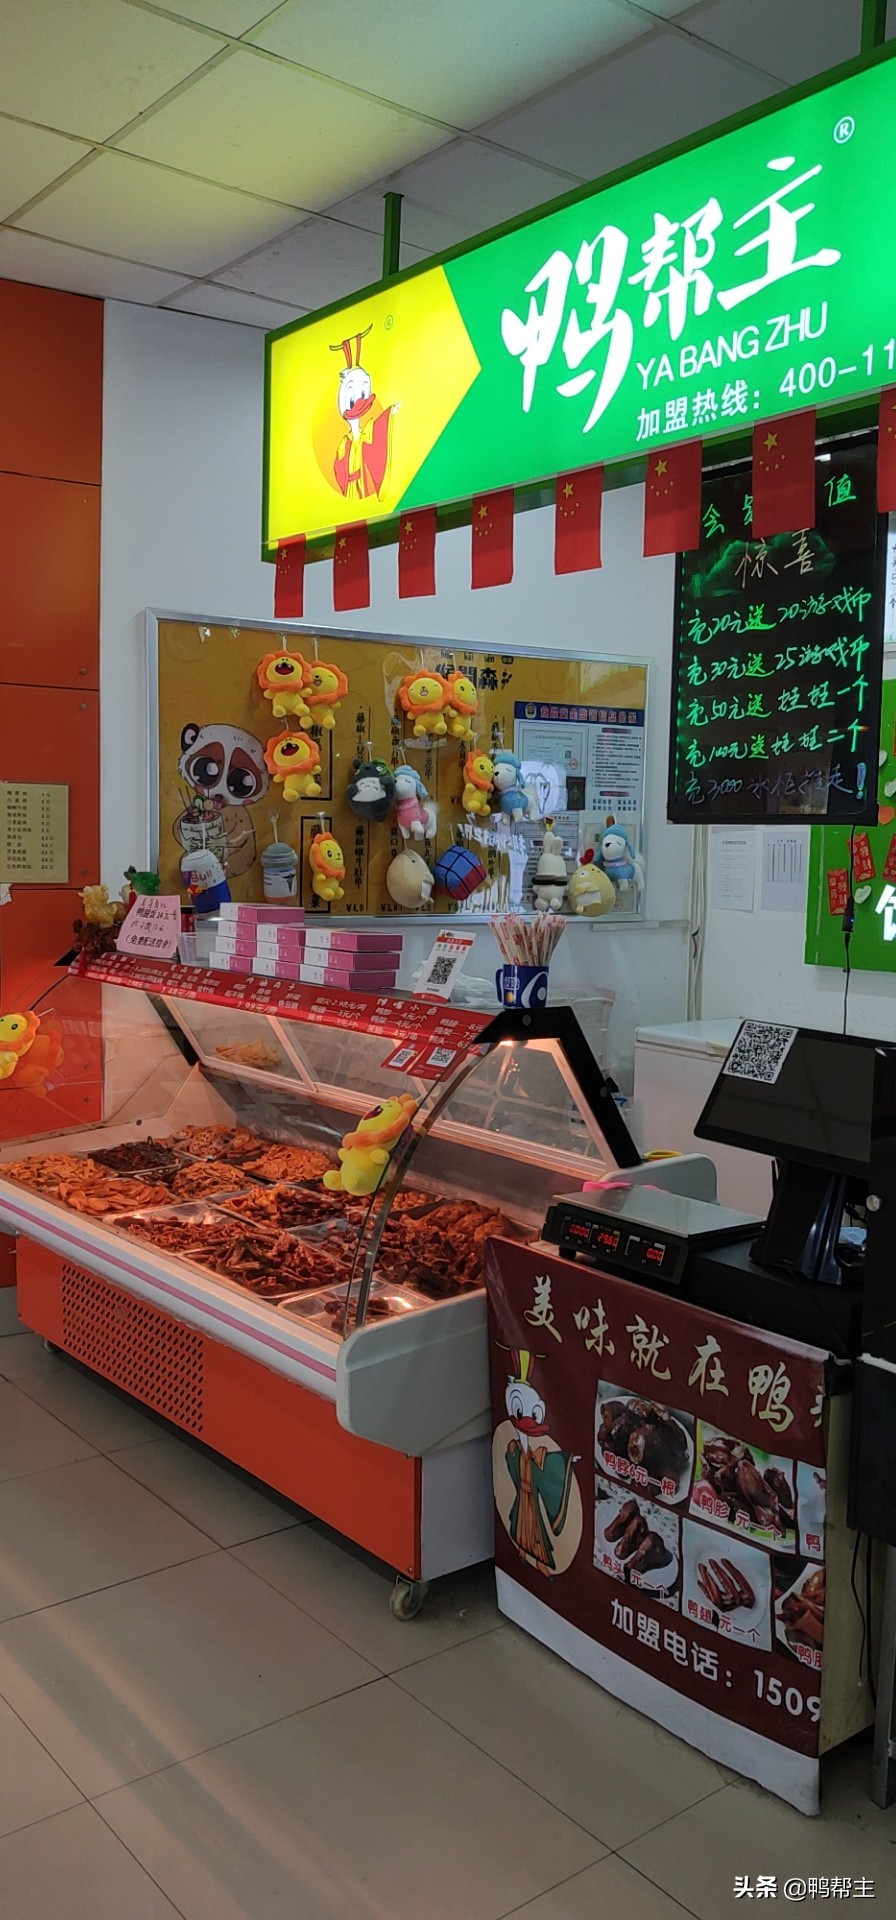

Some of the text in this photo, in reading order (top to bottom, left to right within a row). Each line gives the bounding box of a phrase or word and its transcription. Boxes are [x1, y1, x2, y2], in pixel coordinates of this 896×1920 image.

[501, 156, 841, 433] 鸭帮主
[636, 301, 828, 390] YA BANG ZHU
[635, 379, 760, 441] 加盟热线：
[734, 527, 816, 589] 惊喜
[603, 1450, 677, 1498] 鸭脖6元一根
[700, 1494, 783, 1542] 鸭胗元一个
[602, 1553, 670, 1600] 鸭头元一个
[610, 1598, 732, 1688] 加盟电话：
[687, 1599, 761, 1643] 鸭翅元一个
